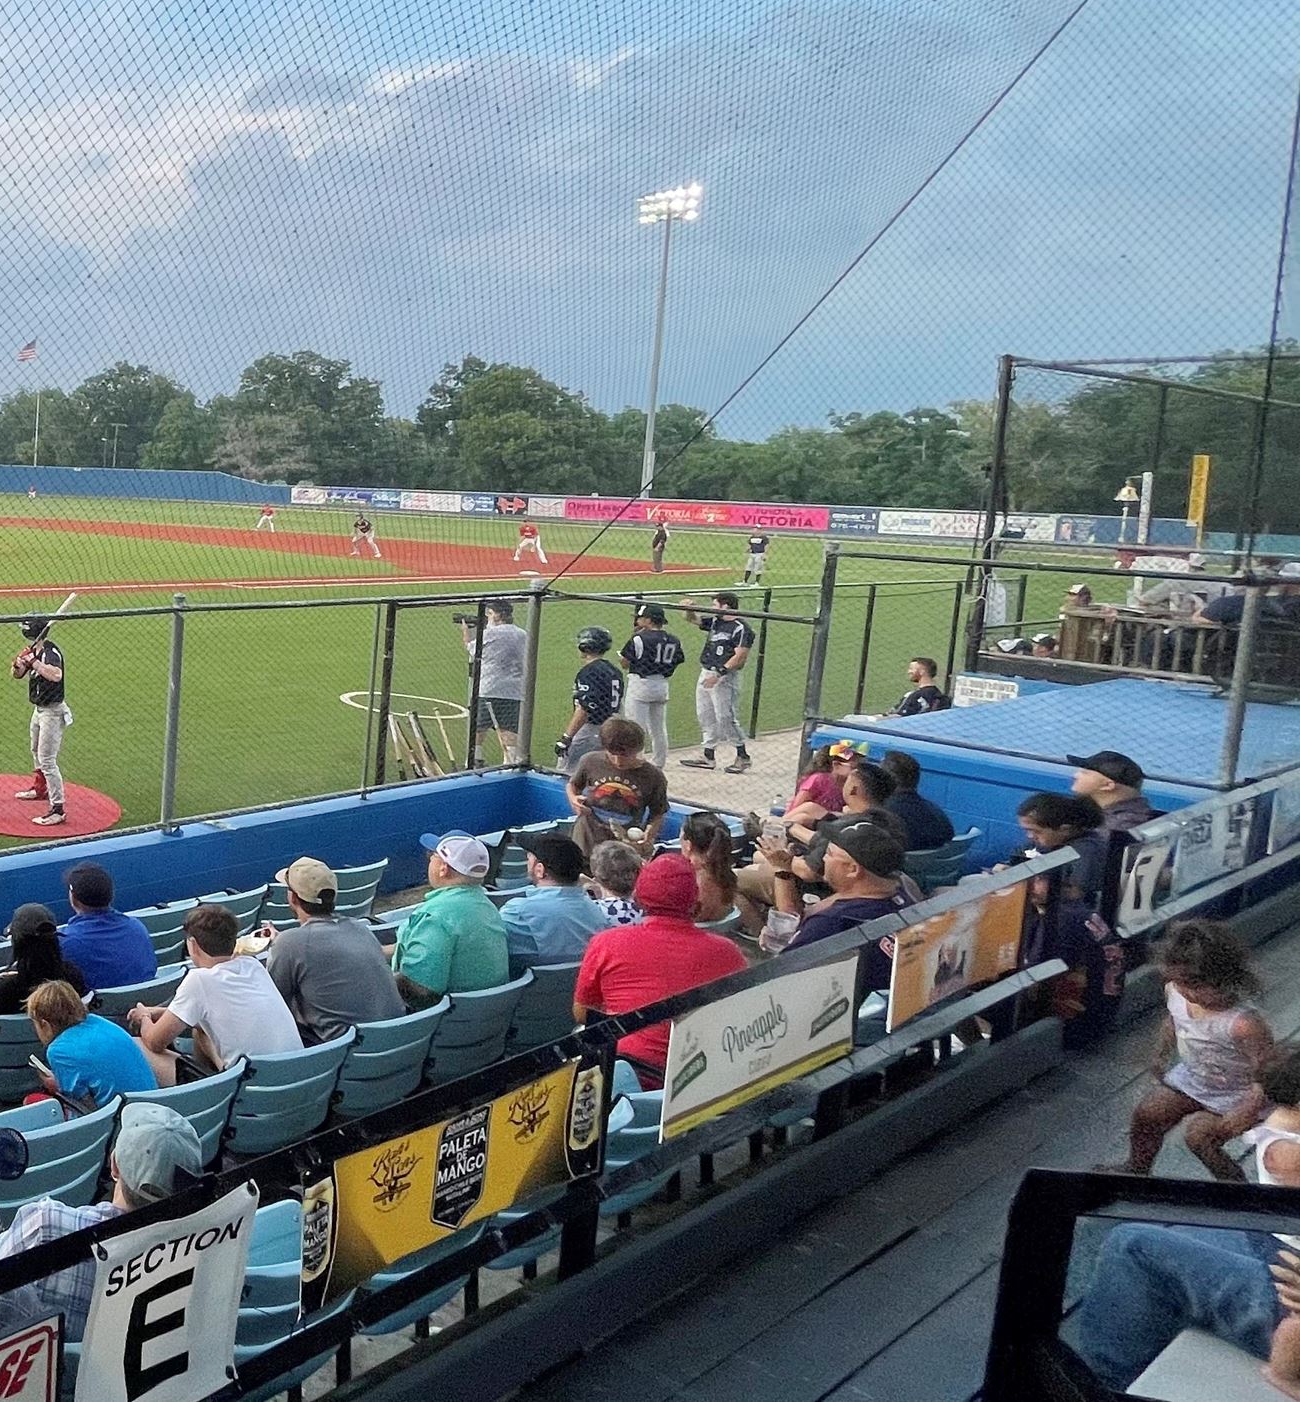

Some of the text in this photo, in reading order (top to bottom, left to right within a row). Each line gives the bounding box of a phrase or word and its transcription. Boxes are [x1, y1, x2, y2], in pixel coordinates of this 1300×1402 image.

[742, 514, 813, 527] VICTORIA
[654, 642, 676, 664] 10
[611, 679, 620, 708] 5
[722, 995, 788, 1063] Pineapple
[439, 1127, 487, 1160] PALETA
[457, 1150, 468, 1162] DE
[437, 1152, 485, 1186] MANGO
[105, 1217, 243, 1298] SECTION
[124, 1266, 195, 1402] E
